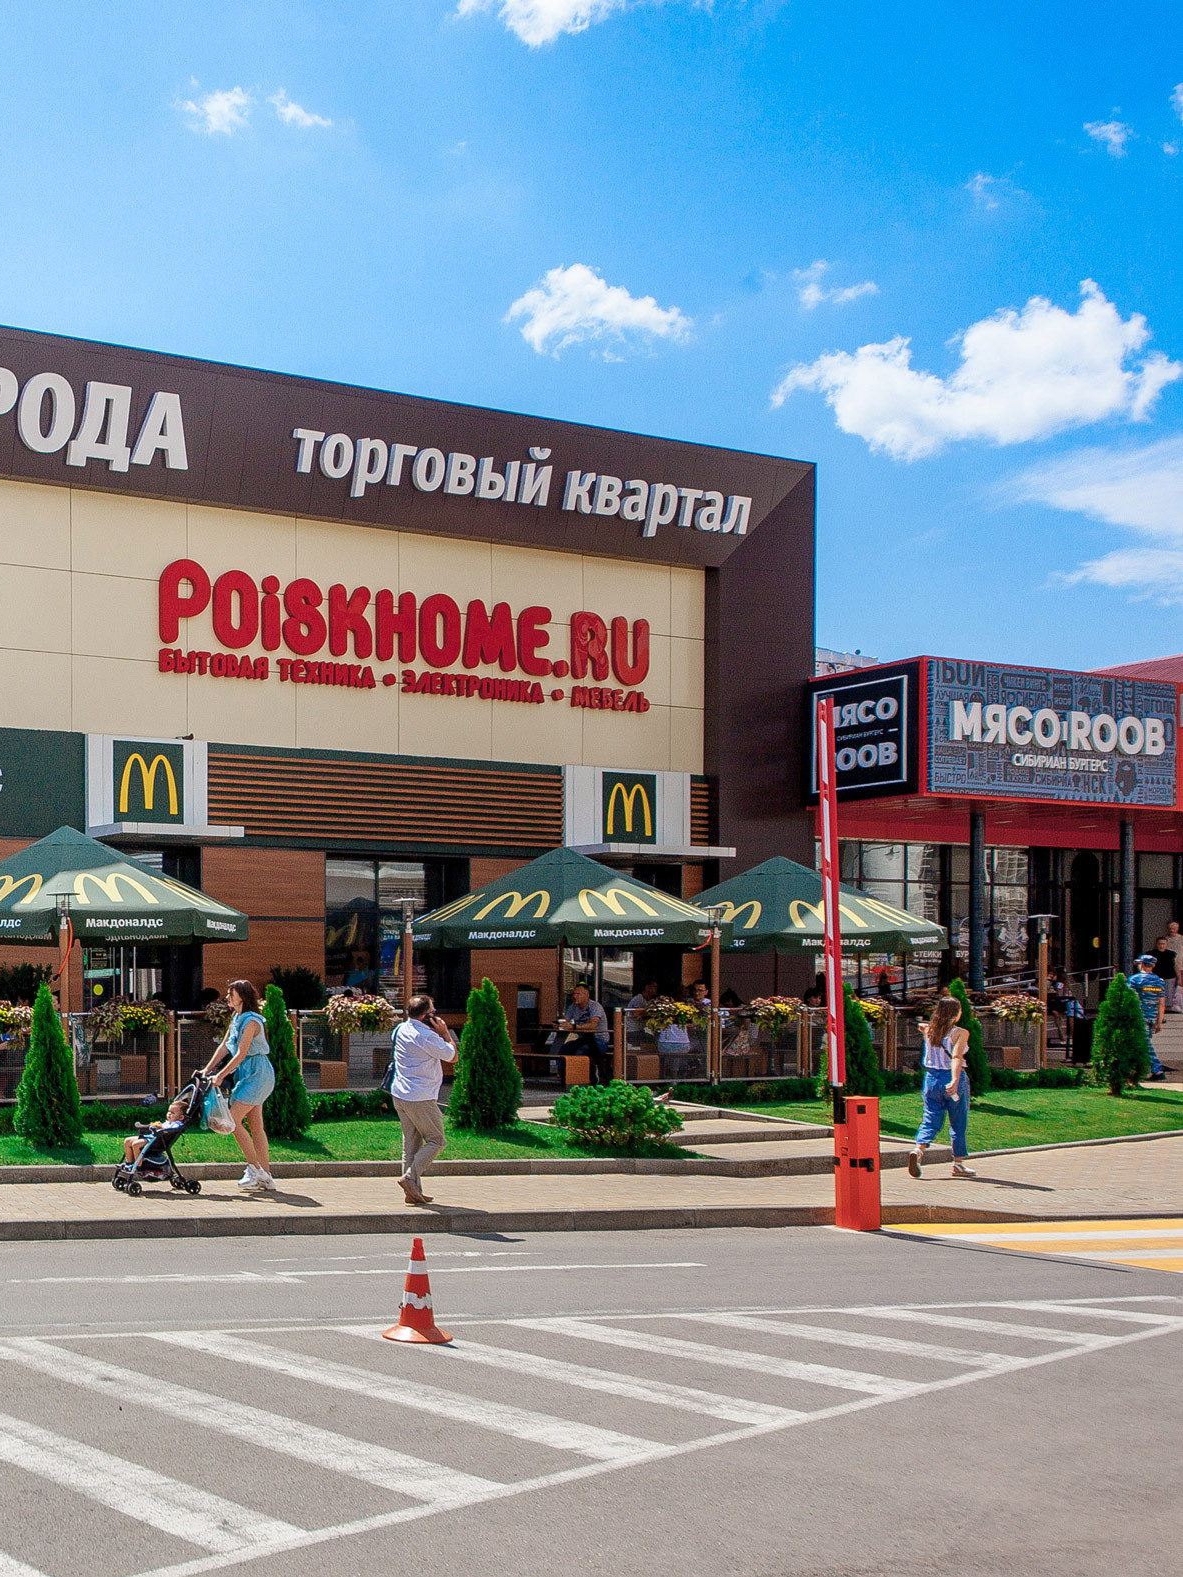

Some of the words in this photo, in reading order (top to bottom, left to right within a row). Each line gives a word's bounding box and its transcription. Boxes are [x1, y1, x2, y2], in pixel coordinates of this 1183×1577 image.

[293, 427, 553, 507] торговый
[563, 468, 752, 538] квартал
[159, 648, 269, 681] БЫТОВАЯ
[277, 657, 376, 690] ТЕХНИКА
[402, 669, 544, 705] ЭЛЕКТРОНИКА
[570, 684, 651, 713] МЕБЕЛЬ
[949, 700, 1061, 748] МЯСО
[1067, 710, 1166, 756] ROOB
[834, 741, 899, 772] OOB
[1012, 753, 1067, 769] СИБИРИАН
[1068, 757, 1109, 773] БУРГЕРС
[934, 772, 966, 785] БЫСТРО
[85, 918, 164, 929] Макдоналдс
[593, 928, 665, 938] Макдоналдс
[468, 929, 537, 940] Макдоналдс
